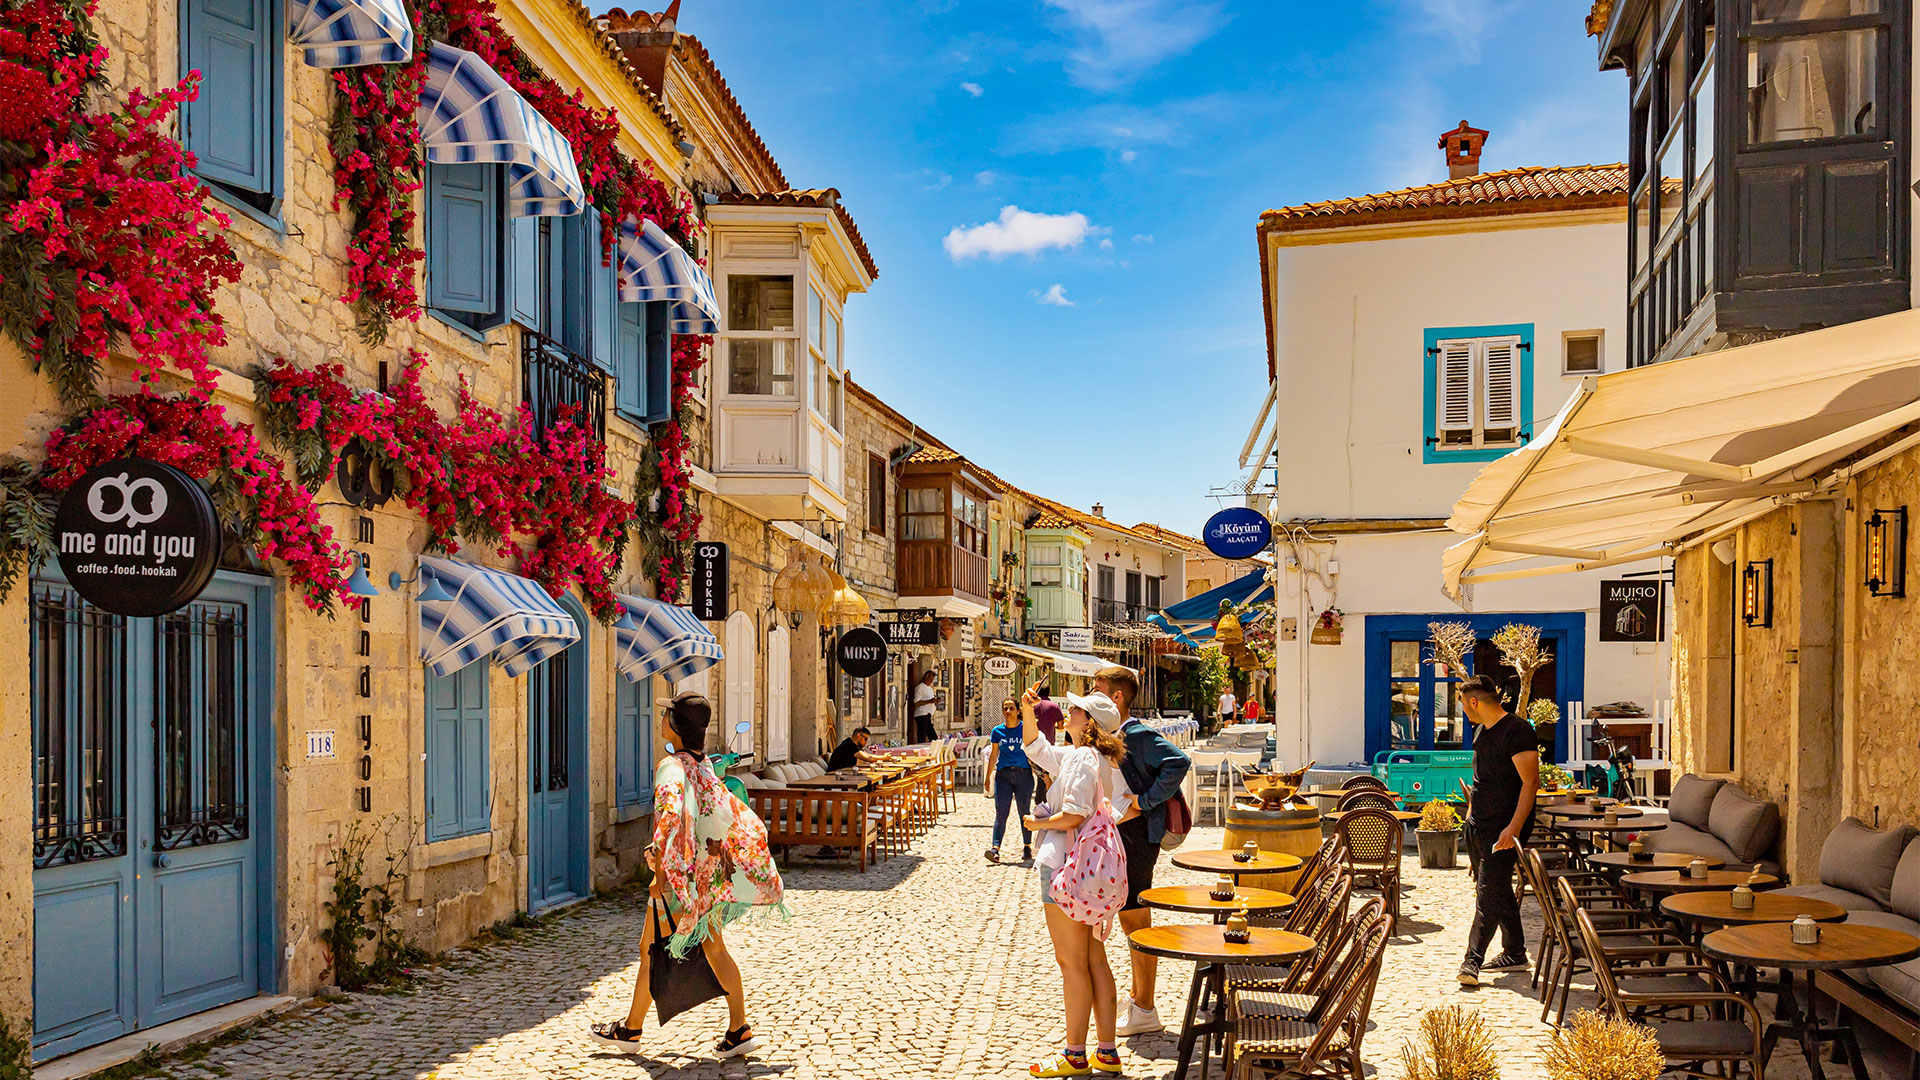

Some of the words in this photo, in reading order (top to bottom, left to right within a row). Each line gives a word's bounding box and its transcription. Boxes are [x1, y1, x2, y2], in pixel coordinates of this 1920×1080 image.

[61, 531, 96, 553] me
[105, 530, 147, 556] and
[153, 535, 195, 564] you
[77, 563, 108, 574] coffee
[141, 566, 177, 577] hookah
[705, 559, 713, 617] hookah
[360, 597, 371, 698] and
[844, 646, 880, 660] MOST
[310, 736, 331, 753] 118
[361, 715, 372, 812] you
